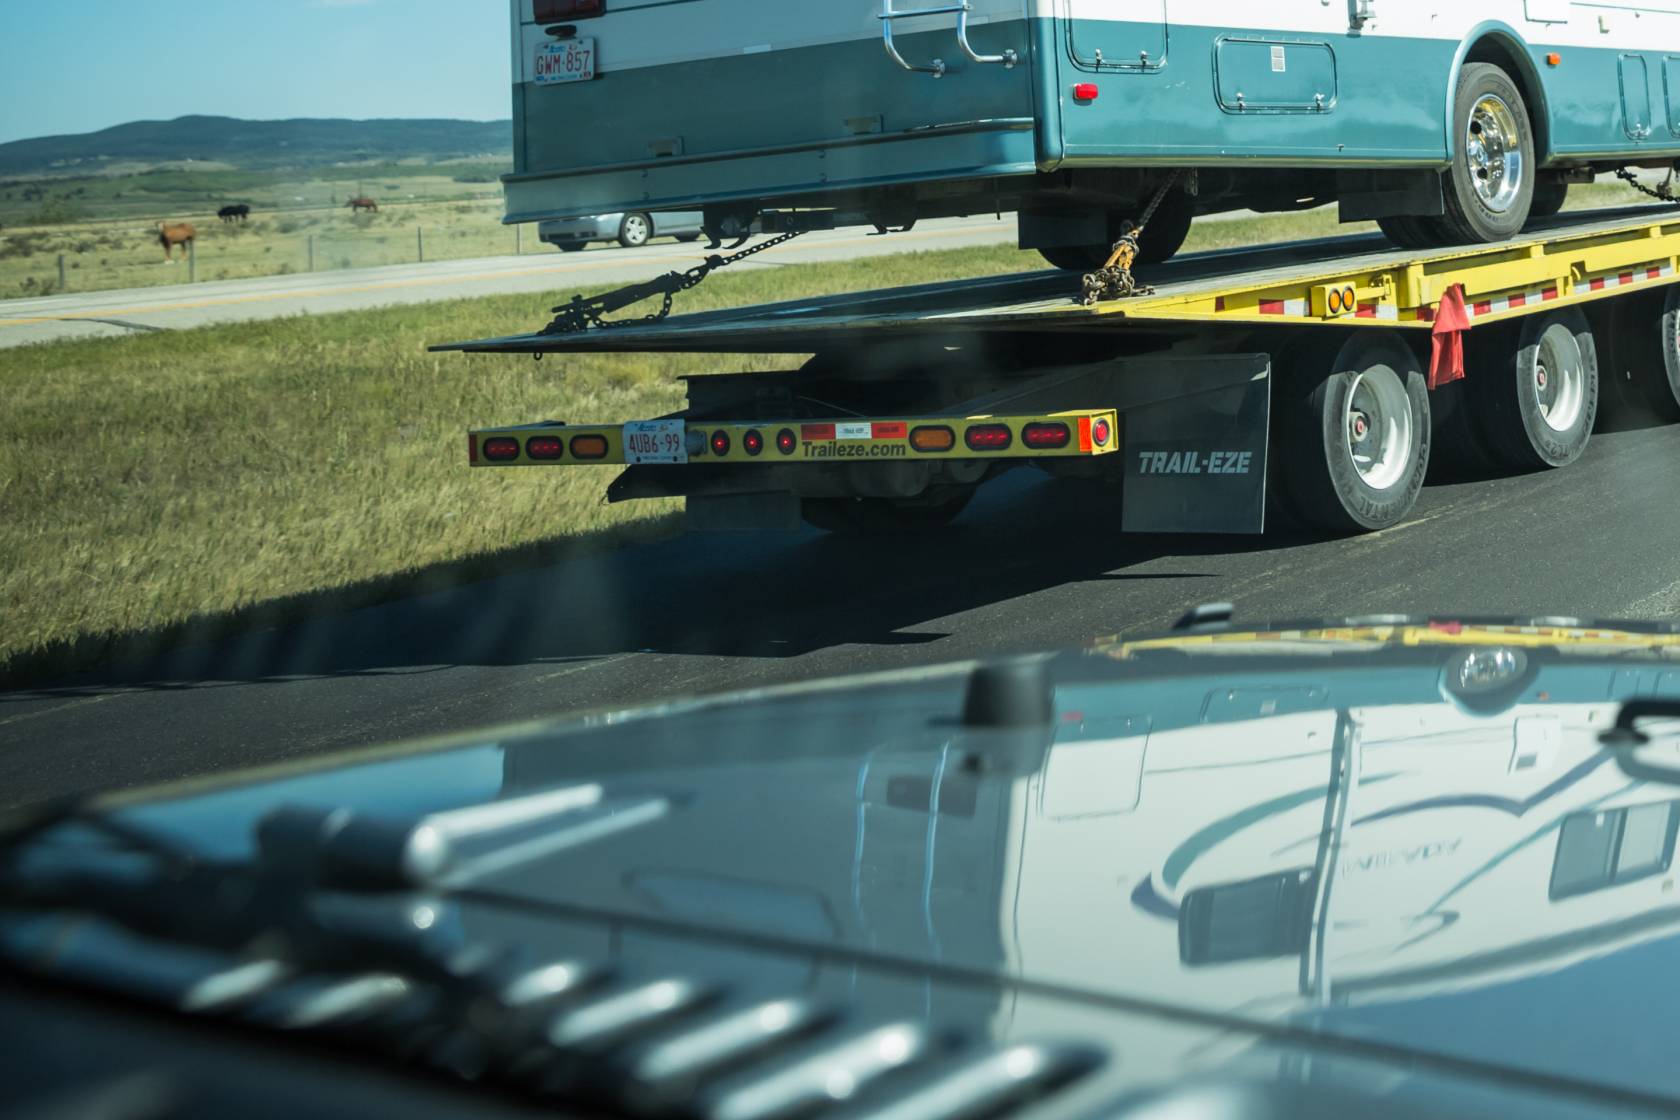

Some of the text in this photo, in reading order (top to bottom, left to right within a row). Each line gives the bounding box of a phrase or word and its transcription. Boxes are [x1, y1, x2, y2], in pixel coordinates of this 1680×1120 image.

[536, 49, 590, 75] GWM-857
[629, 433, 680, 455] 4UB6-99
[802, 441, 906, 457] Traileze.com
[1139, 451, 1252, 473] TRAIL-EZE
